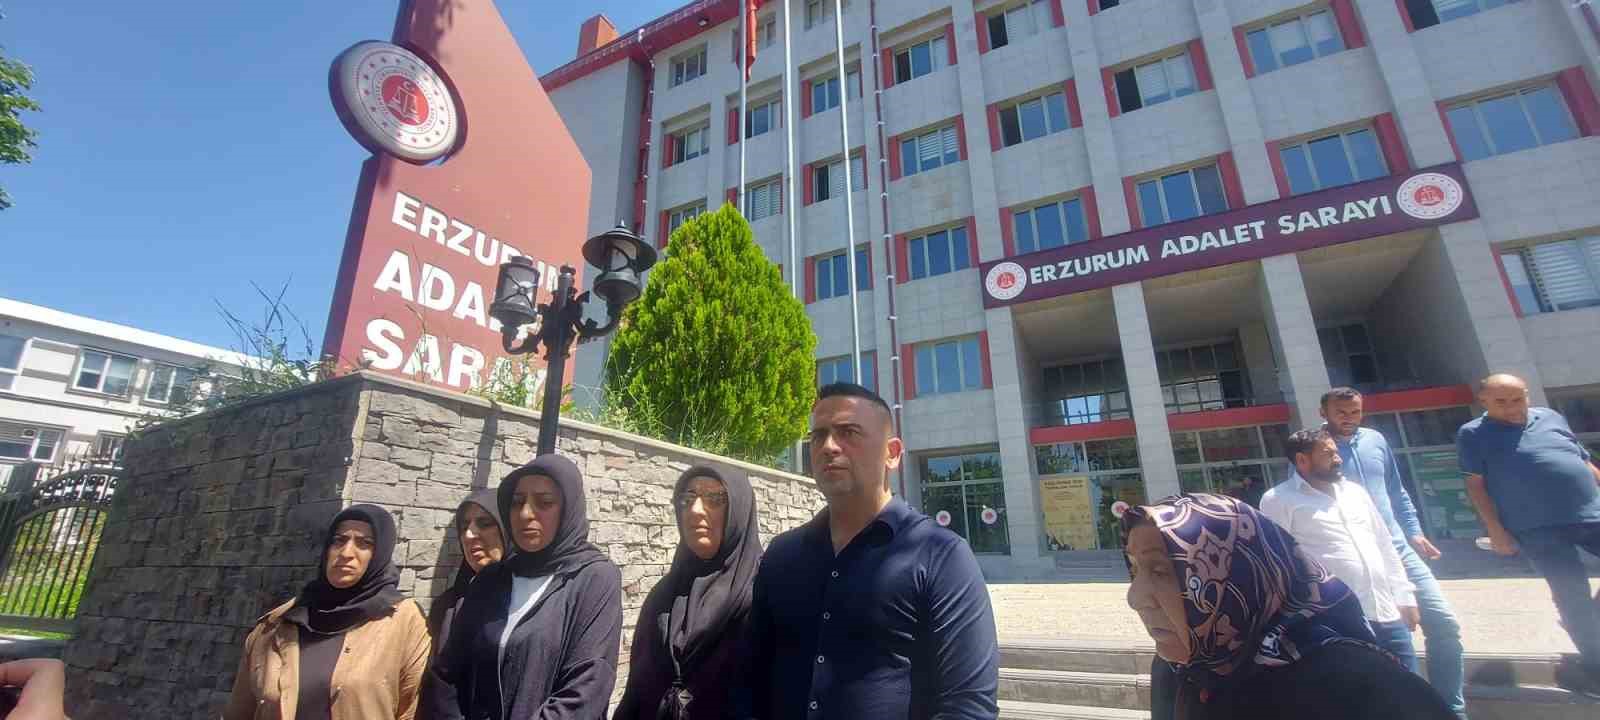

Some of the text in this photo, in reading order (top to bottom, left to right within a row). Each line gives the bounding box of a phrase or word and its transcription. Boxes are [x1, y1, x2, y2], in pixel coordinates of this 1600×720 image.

[1030, 195, 1393, 284] ERZURUM ADALET SARAYI
[374, 250, 541, 341] ADA
[362, 319, 548, 408] SARAY
